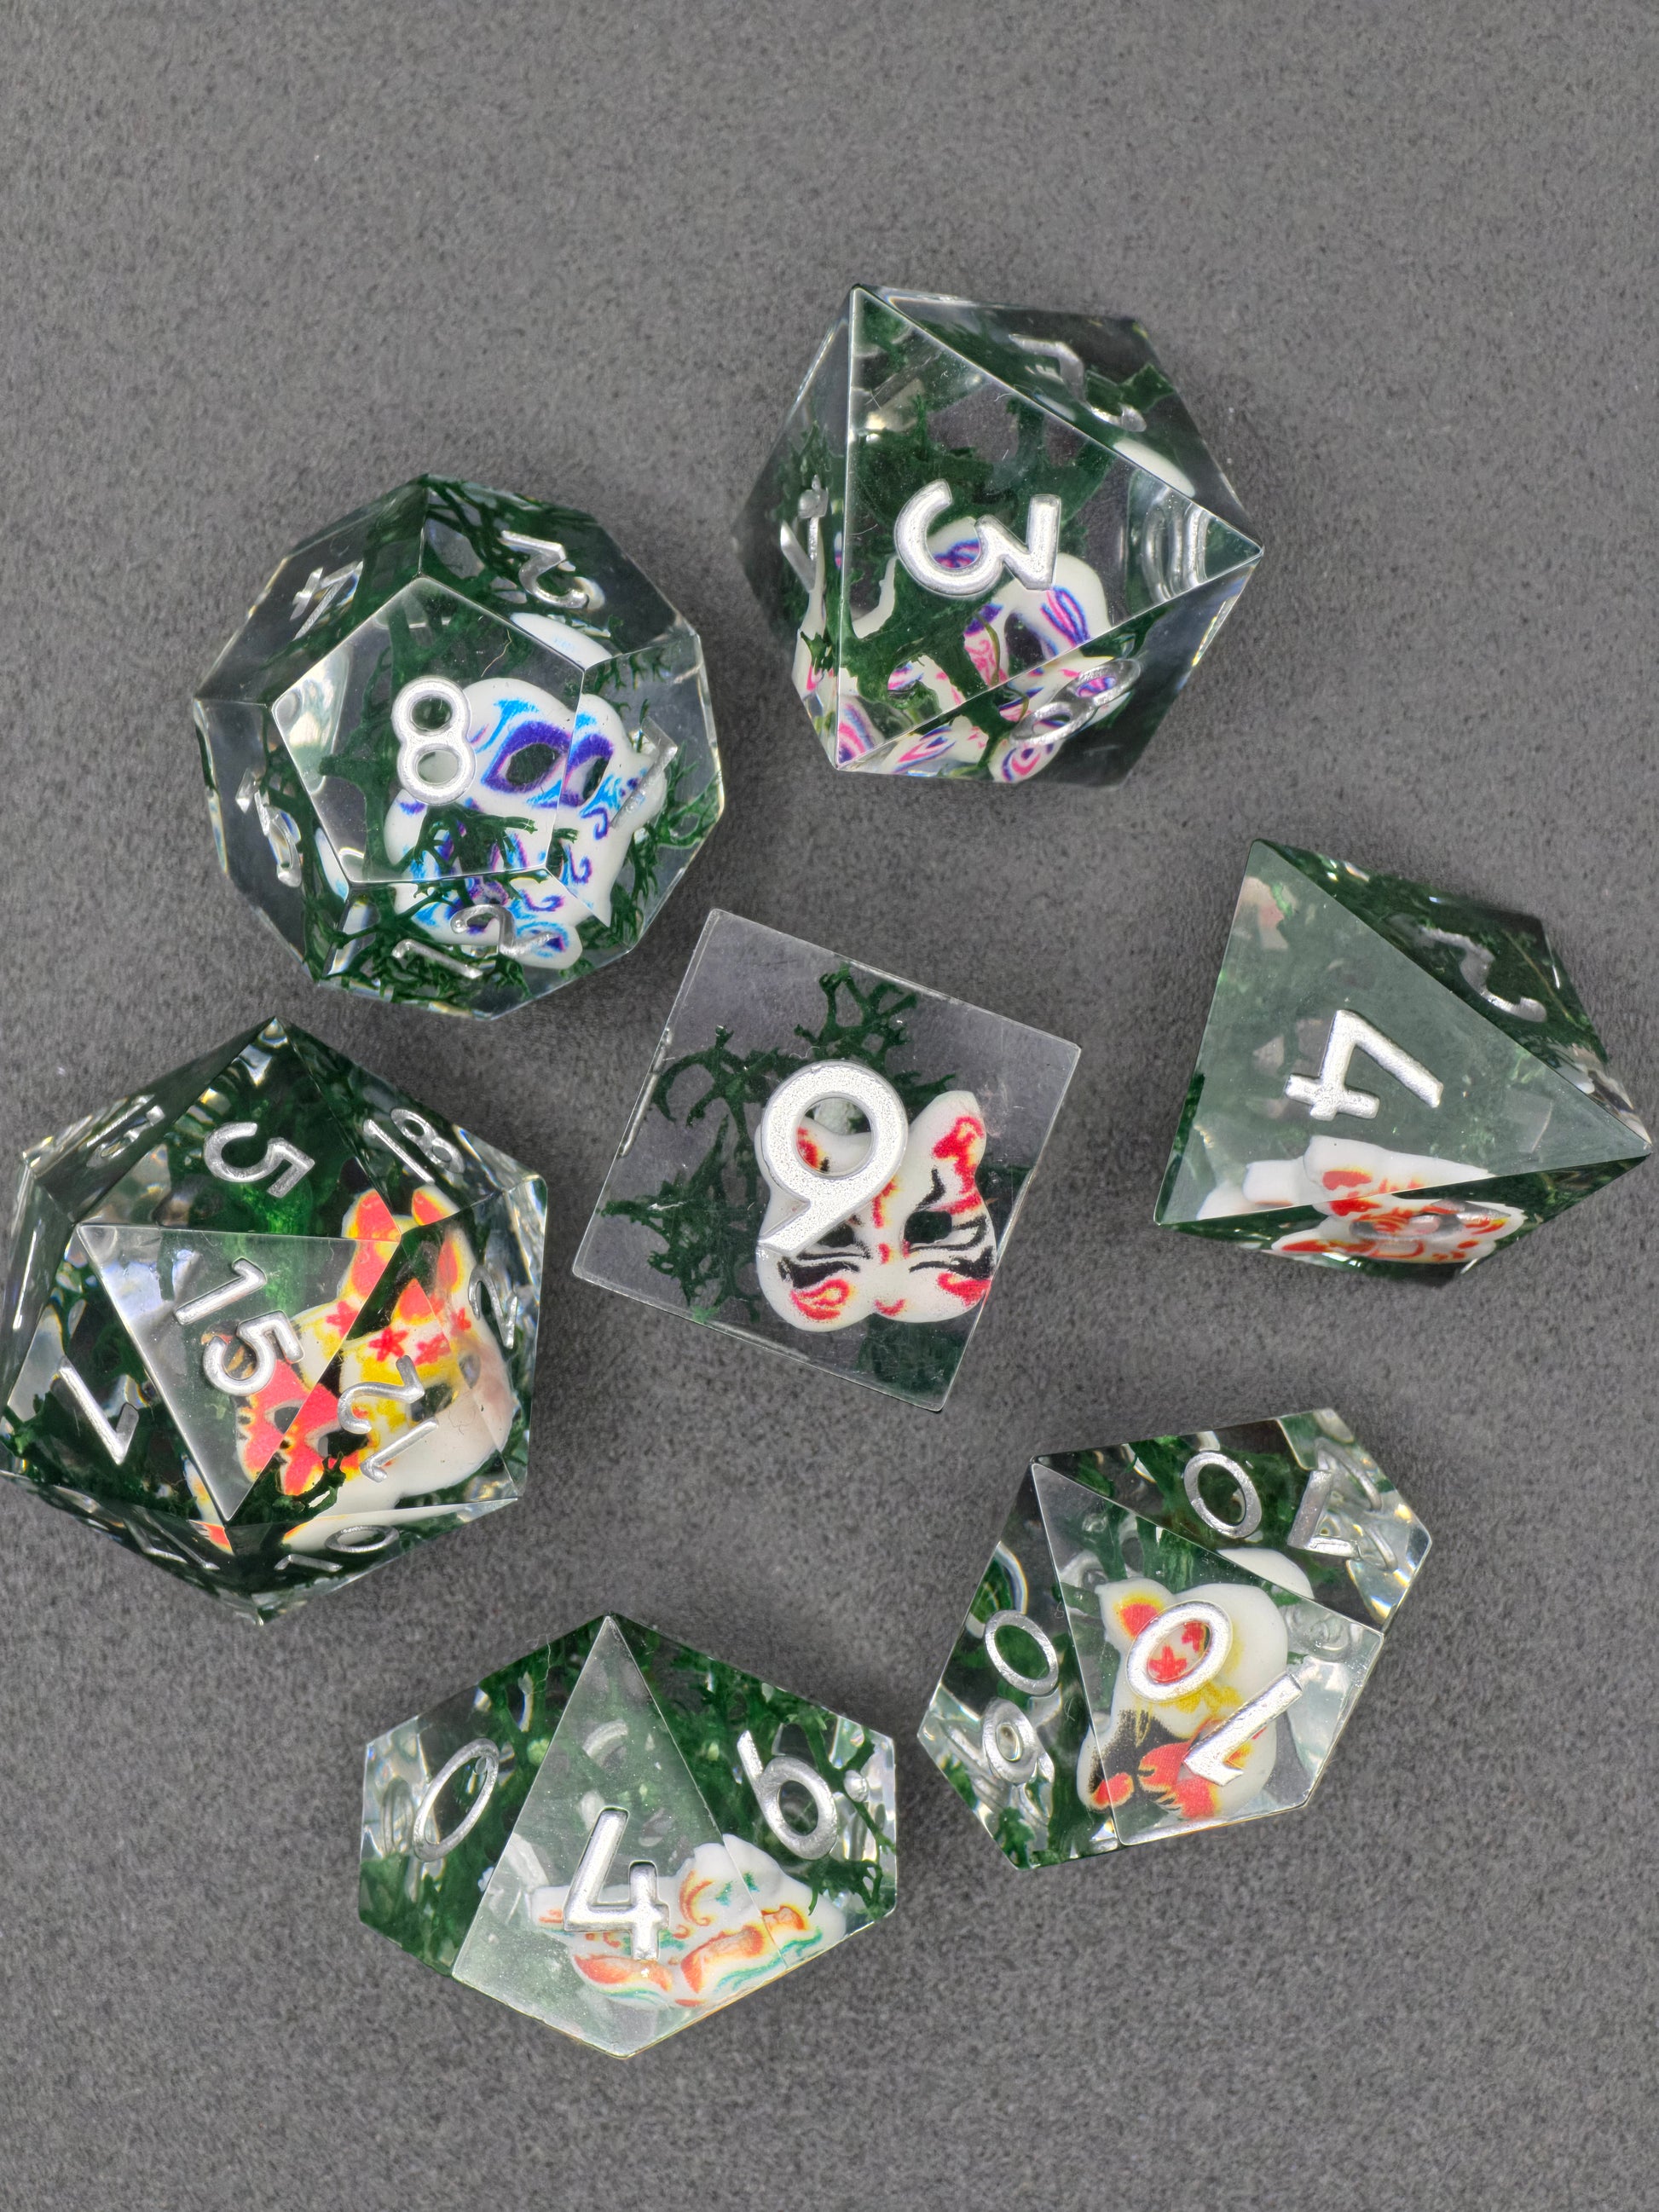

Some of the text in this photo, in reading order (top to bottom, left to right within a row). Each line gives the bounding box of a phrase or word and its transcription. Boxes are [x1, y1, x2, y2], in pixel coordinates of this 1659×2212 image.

[391, 675, 474, 806] 8
[1285, 1008, 1445, 1122] 4
[203, 1121, 315, 1198] 5
[362, 1107, 466, 1186] 18
[174, 1257, 306, 1398] 15
[413, 1737, 501, 1863] 0
[562, 1805, 672, 1961] 4
